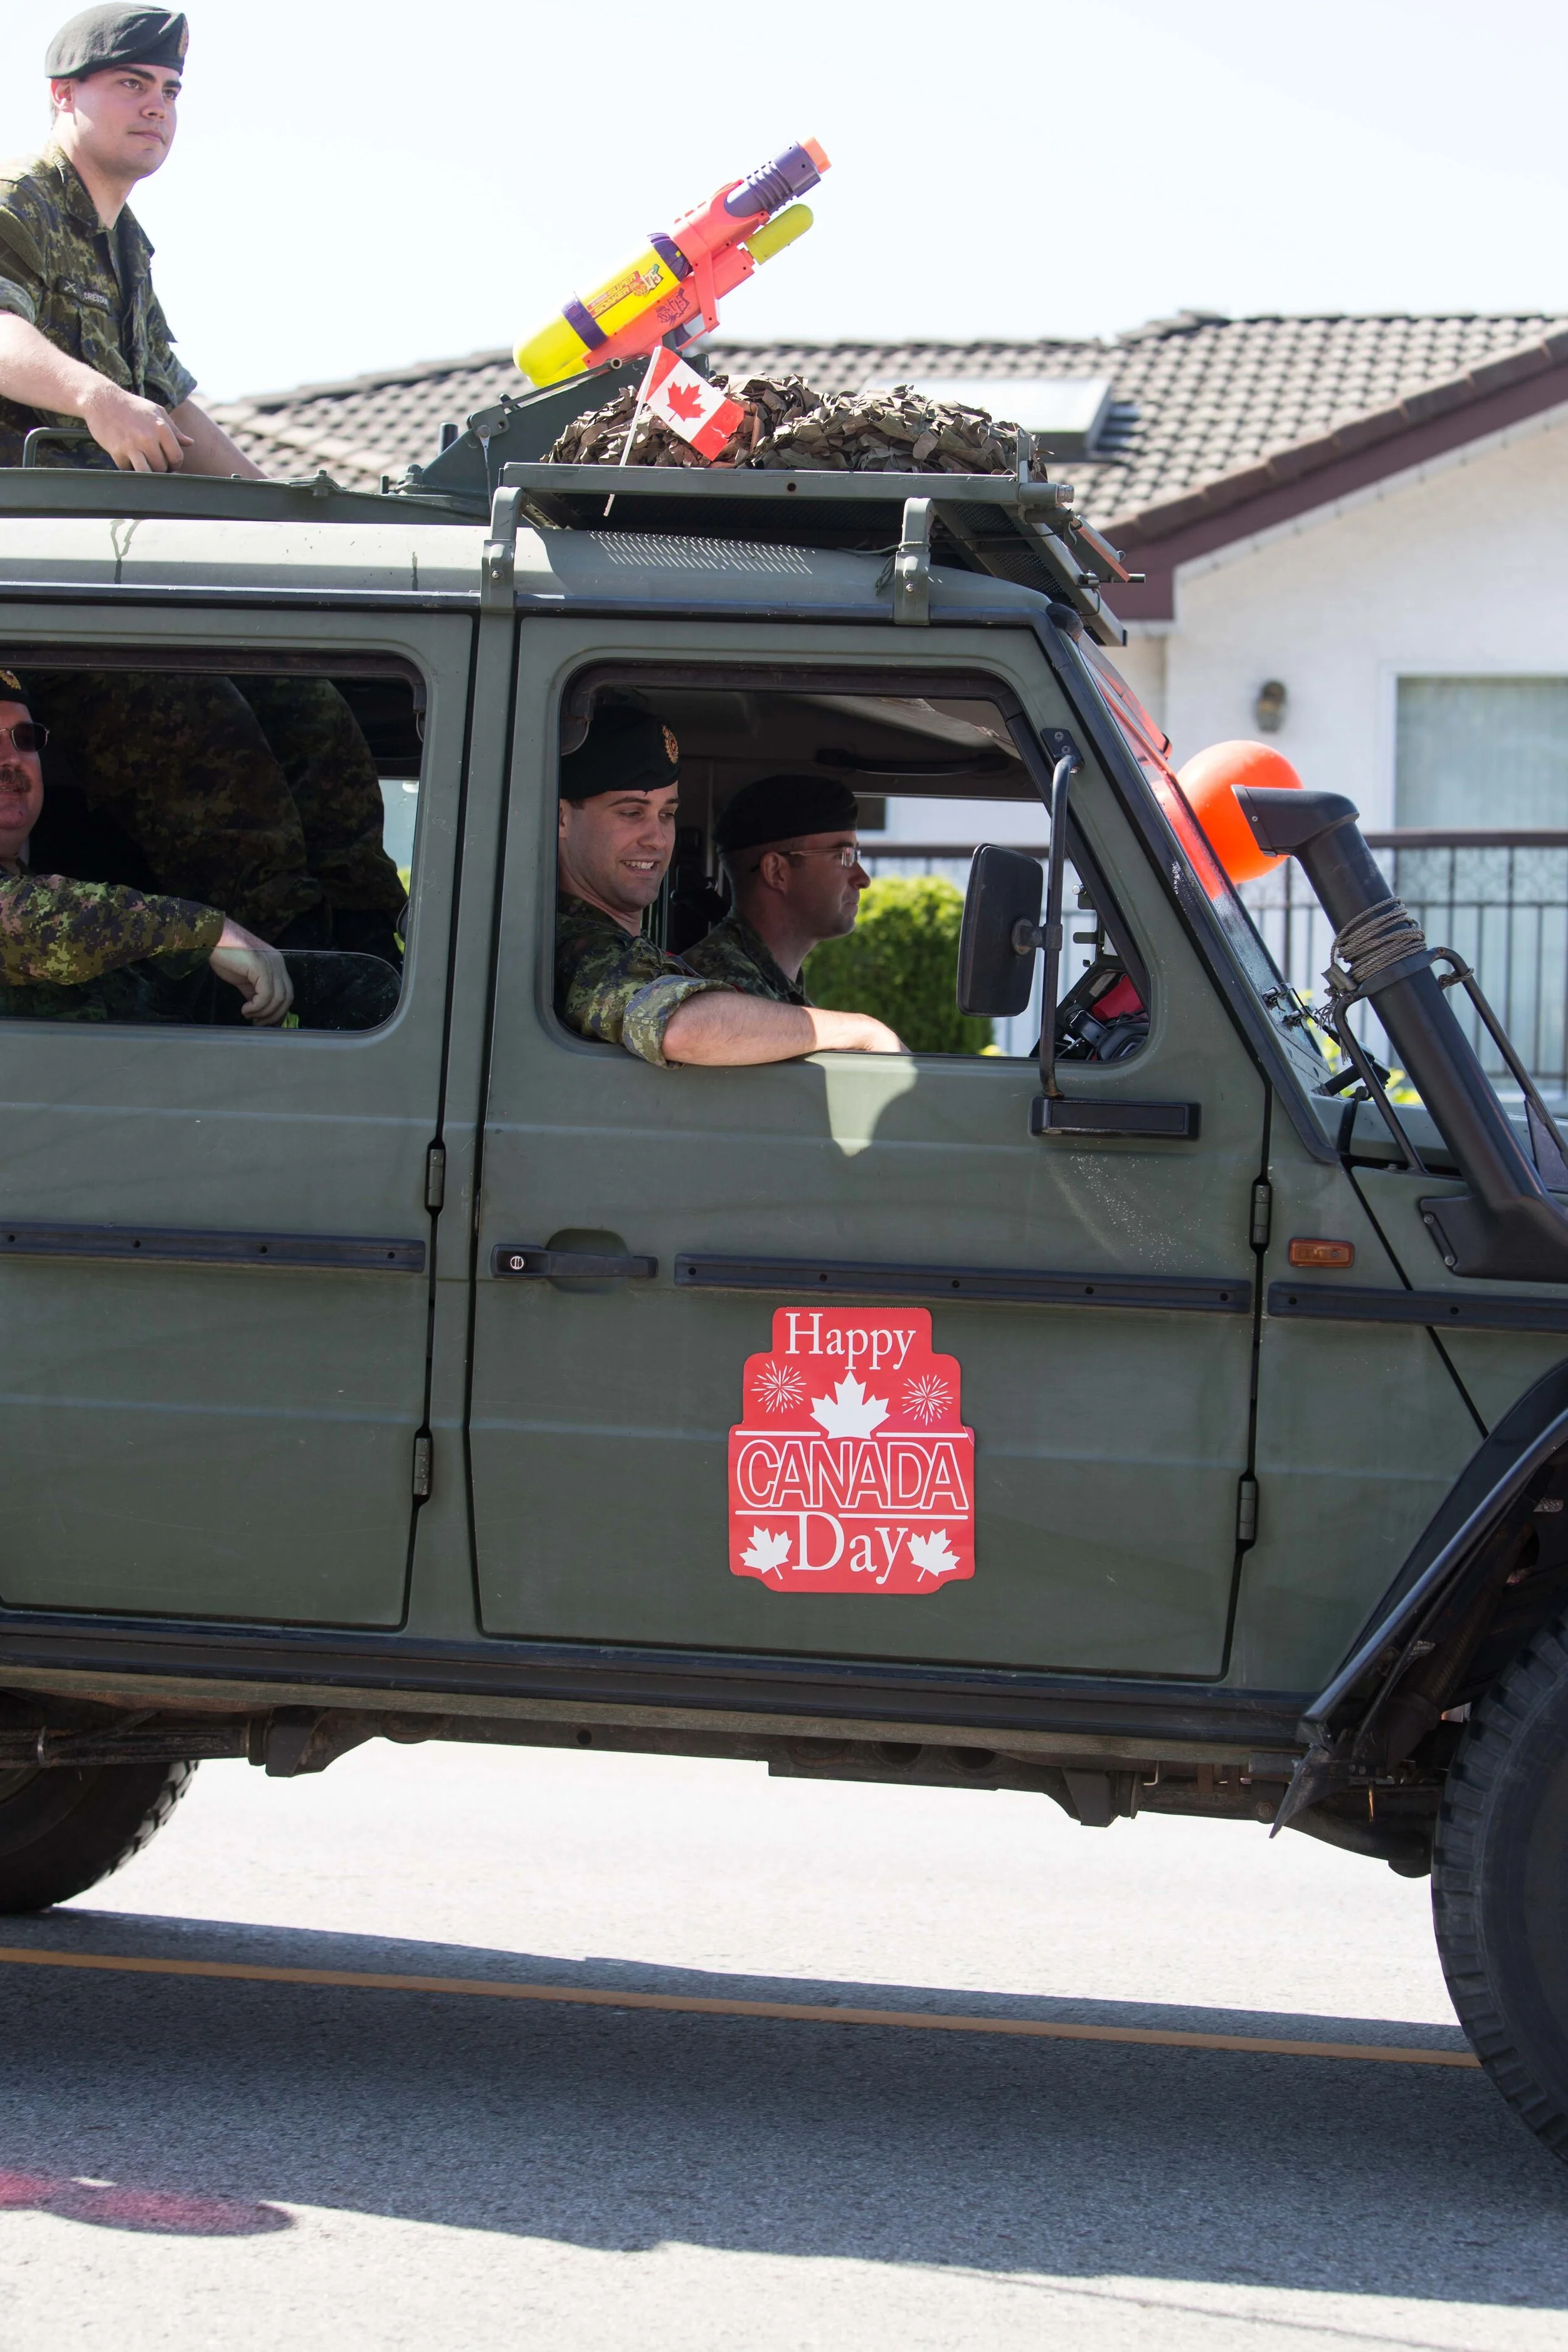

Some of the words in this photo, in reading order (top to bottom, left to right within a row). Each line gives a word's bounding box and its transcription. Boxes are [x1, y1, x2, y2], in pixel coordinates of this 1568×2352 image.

[593, 285, 631, 314] SOAKER
[606, 272, 635, 297] SUPER
[785, 1313, 916, 1370] Happy
[737, 1439, 969, 1510] CANADA
[792, 1511, 909, 1585] Day
